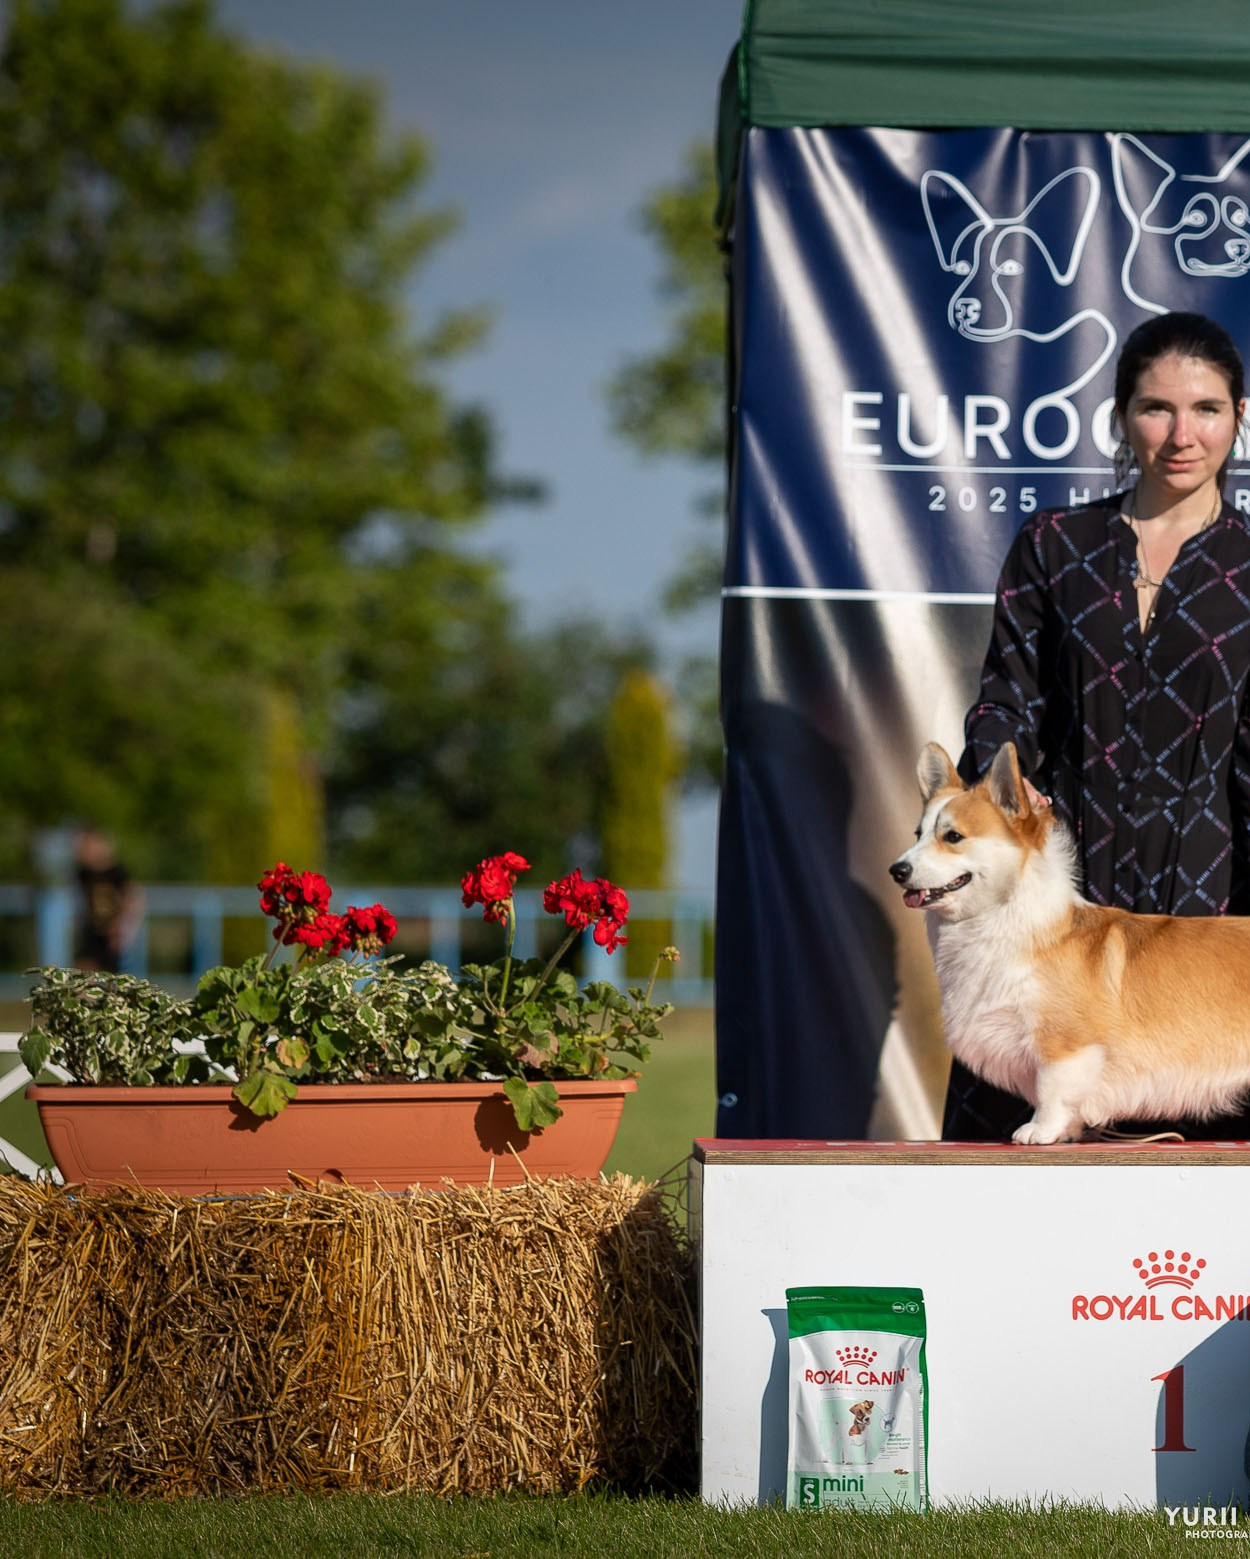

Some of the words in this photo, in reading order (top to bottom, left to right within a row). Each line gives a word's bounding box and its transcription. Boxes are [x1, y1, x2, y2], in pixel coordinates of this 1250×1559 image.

[928, 485, 1038, 513] 2025
[1072, 1295, 1164, 1321] ROYAL
[805, 1369, 852, 1385] ROYAL
[856, 1368, 905, 1385] CANIN
[1150, 1364, 1197, 1452] 1
[803, 1483, 815, 1504] S
[823, 1475, 863, 1492] mini
